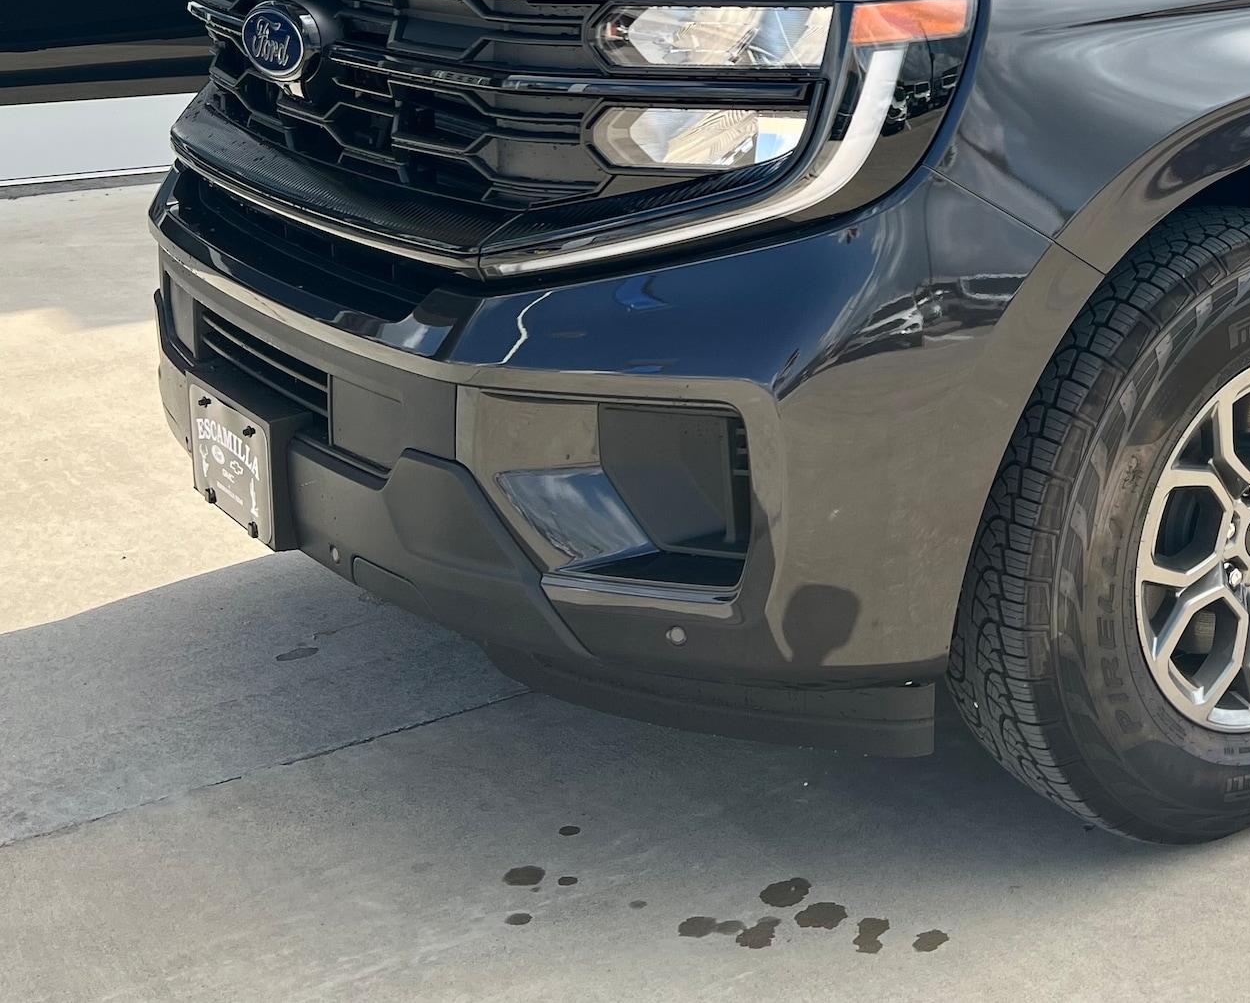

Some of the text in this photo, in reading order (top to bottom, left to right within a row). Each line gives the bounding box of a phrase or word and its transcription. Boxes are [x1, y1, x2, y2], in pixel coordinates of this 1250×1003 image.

[251, 15, 291, 67] Ford
[196, 418, 260, 482] ESCAMILLA
[1096, 517, 1143, 734] PIRELLI
